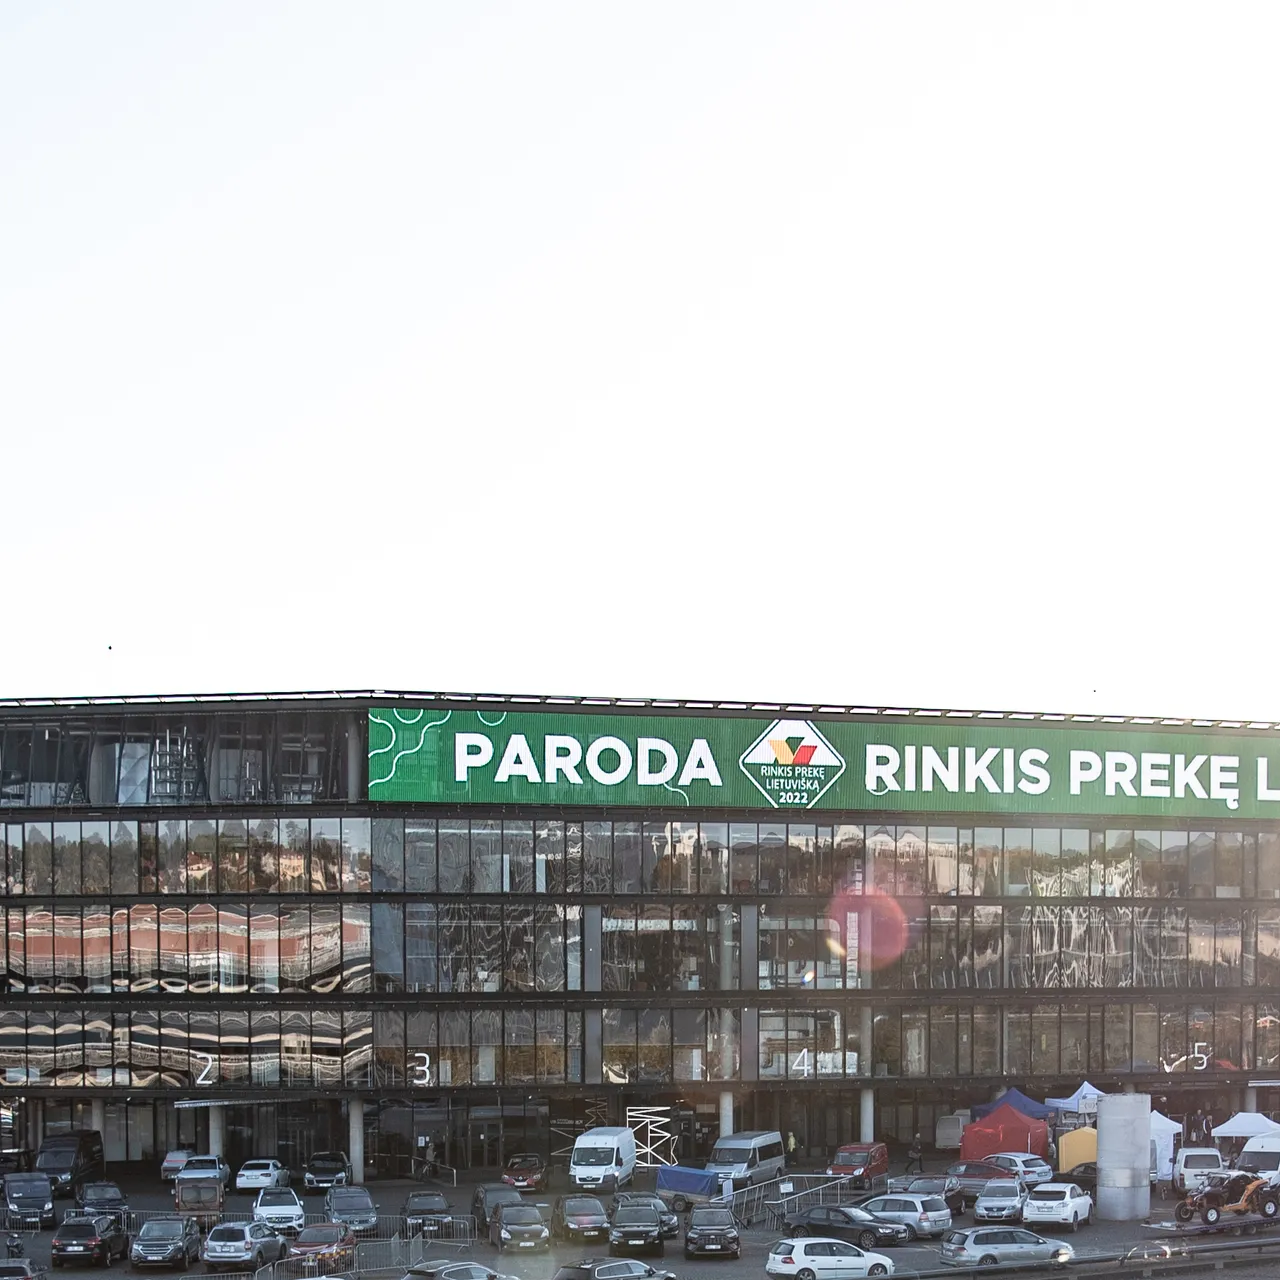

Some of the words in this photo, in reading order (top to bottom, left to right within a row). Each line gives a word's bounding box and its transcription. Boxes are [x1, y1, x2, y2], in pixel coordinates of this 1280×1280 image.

[455, 733, 723, 786] PARODA
[761, 766, 793, 777] RINKIS
[795, 766, 825, 780] PREKĘ
[766, 777, 820, 792] LIETUVIŠKĄ
[864, 744, 1051, 795] RINKIS
[1070, 750, 1240, 810] PREKĘ
[779, 792, 808, 803] 2022
[196, 1054, 213, 1084] 2
[413, 1052, 430, 1084] 3
[792, 1047, 811, 1077] 4
[1193, 1042, 1207, 1070] 5
